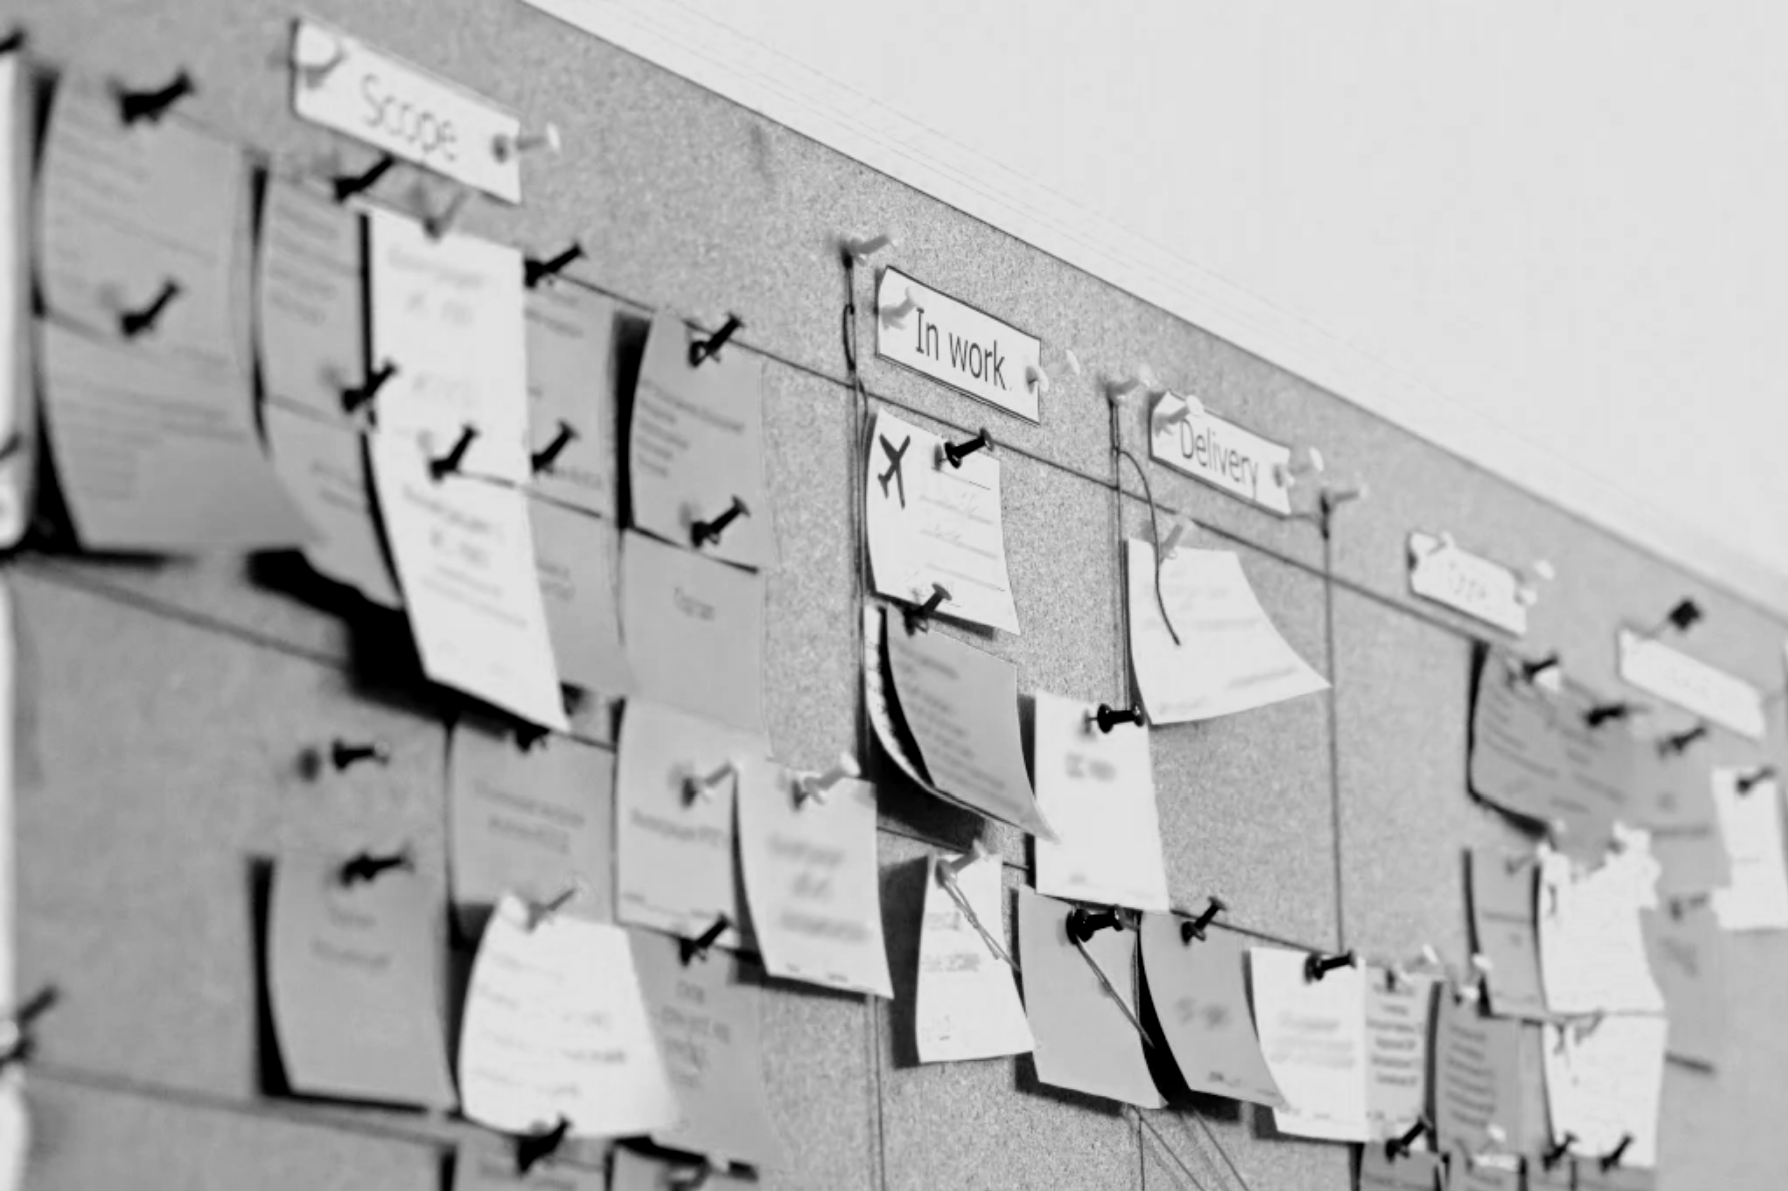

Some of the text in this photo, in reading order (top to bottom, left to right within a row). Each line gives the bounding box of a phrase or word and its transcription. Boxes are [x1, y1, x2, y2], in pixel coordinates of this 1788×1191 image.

[360, 73, 457, 162] Scope
[916, 307, 1006, 391] In work
[1180, 417, 1259, 500] Delivery
